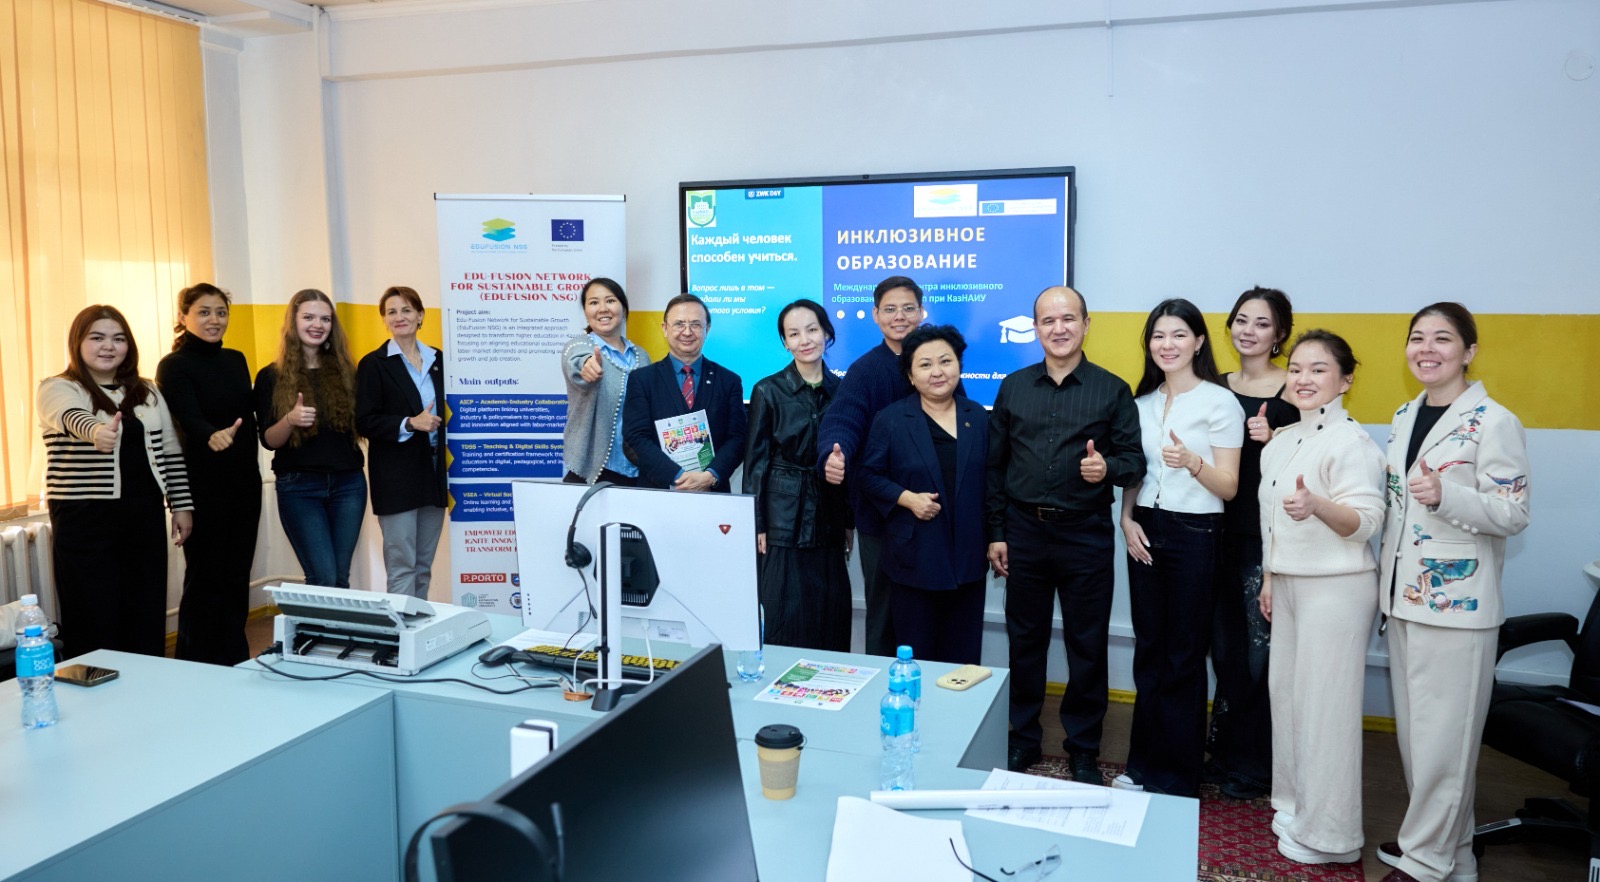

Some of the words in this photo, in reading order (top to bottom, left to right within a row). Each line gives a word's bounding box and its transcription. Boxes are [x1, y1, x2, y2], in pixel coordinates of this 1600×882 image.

[691, 233, 739, 246] Каждый
[743, 234, 792, 244] человек
[837, 226, 985, 244] ИНКЛЮЗИВНОЕ
[691, 251, 746, 263] способен
[748, 252, 798, 264] учиться.
[837, 253, 977, 270] ОБРАЗОВАНИЕ
[536, 272, 591, 281] NETWORK
[451, 283, 473, 291] FOR
[478, 283, 554, 291] SUSTAINABLE
[557, 283, 586, 291] GROW
[692, 284, 718, 293] Вопрос
[834, 283, 876, 292] Междунар
[916, 284, 938, 292] нтра
[940, 282, 1003, 291] инклюзивного
[480, 292, 548, 301] (EDUFUSION
[551, 292, 578, 301] NSG)
[832, 295, 874, 304] образован
[947, 294, 986, 302] КазНАИУ
[731, 306, 766, 316] условия?
[485, 378, 519, 386] outputs:
